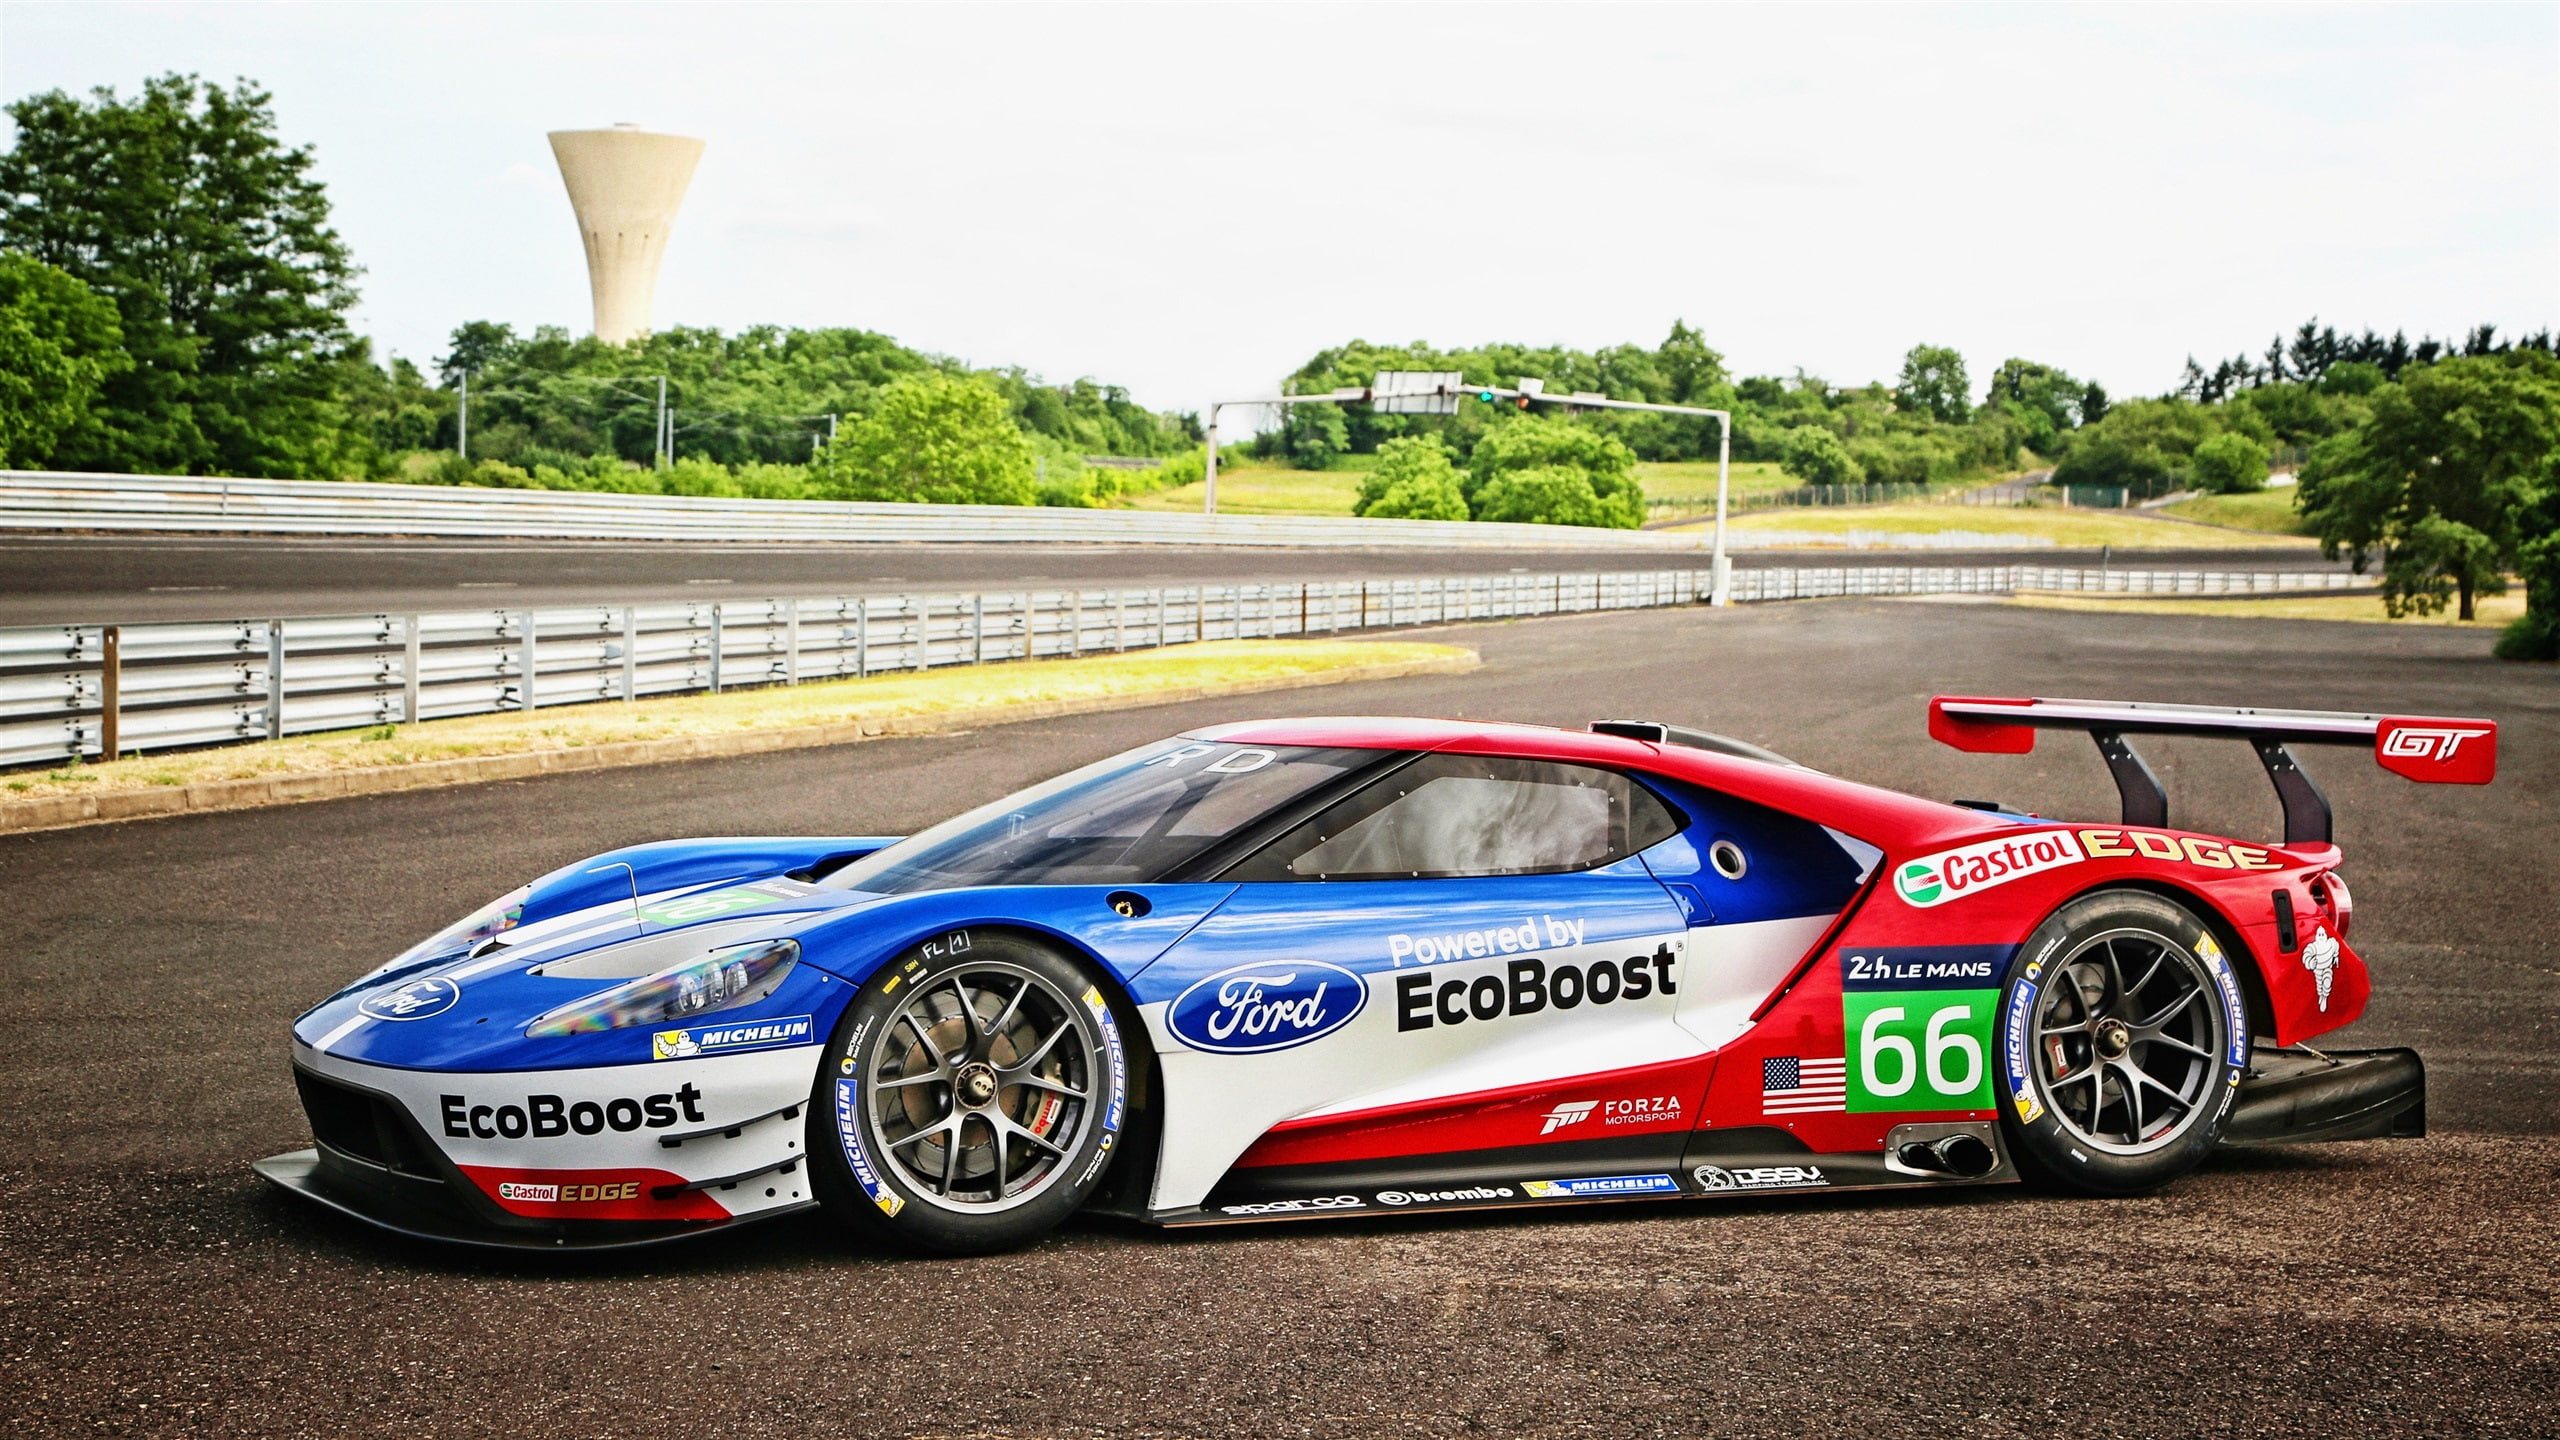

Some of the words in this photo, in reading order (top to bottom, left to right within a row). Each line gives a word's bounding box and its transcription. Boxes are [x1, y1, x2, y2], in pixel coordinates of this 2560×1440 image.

[1942, 838, 2074, 891] Castrol
[2079, 829, 2284, 871] EDGE
[922, 942, 945, 959] FL
[1388, 918, 1544, 968] Powered
[1544, 914, 1586, 948] by
[1396, 942, 1677, 1032] EcoBoost
[1848, 956, 1890, 982] 24h
[1895, 964, 1921, 979] LE
[1927, 961, 1992, 979] MANS
[368, 981, 442, 1014] Ford
[1207, 972, 1328, 1040] Ford
[2221, 972, 2244, 1063] MICHELIN
[701, 1022, 808, 1045] MICHELIN
[1860, 1006, 1984, 1097] 66
[2009, 983, 2030, 1079] MICHELIN
[1105, 1020, 1124, 1128] MICHELIN
[440, 1081, 704, 1139] EcoBoost
[1605, 1096, 1681, 1115] FORZA
[1605, 1111, 1681, 1125] MOTORSPORT
[838, 1082, 875, 1186] MICHELIN
[513, 1185, 555, 1199] Castrol
[560, 1182, 641, 1201] EDGE
[1221, 1195, 1367, 1214] sparco
[1409, 1186, 1514, 1203] brembo
[1571, 1177, 1670, 1191] MICHELIN
